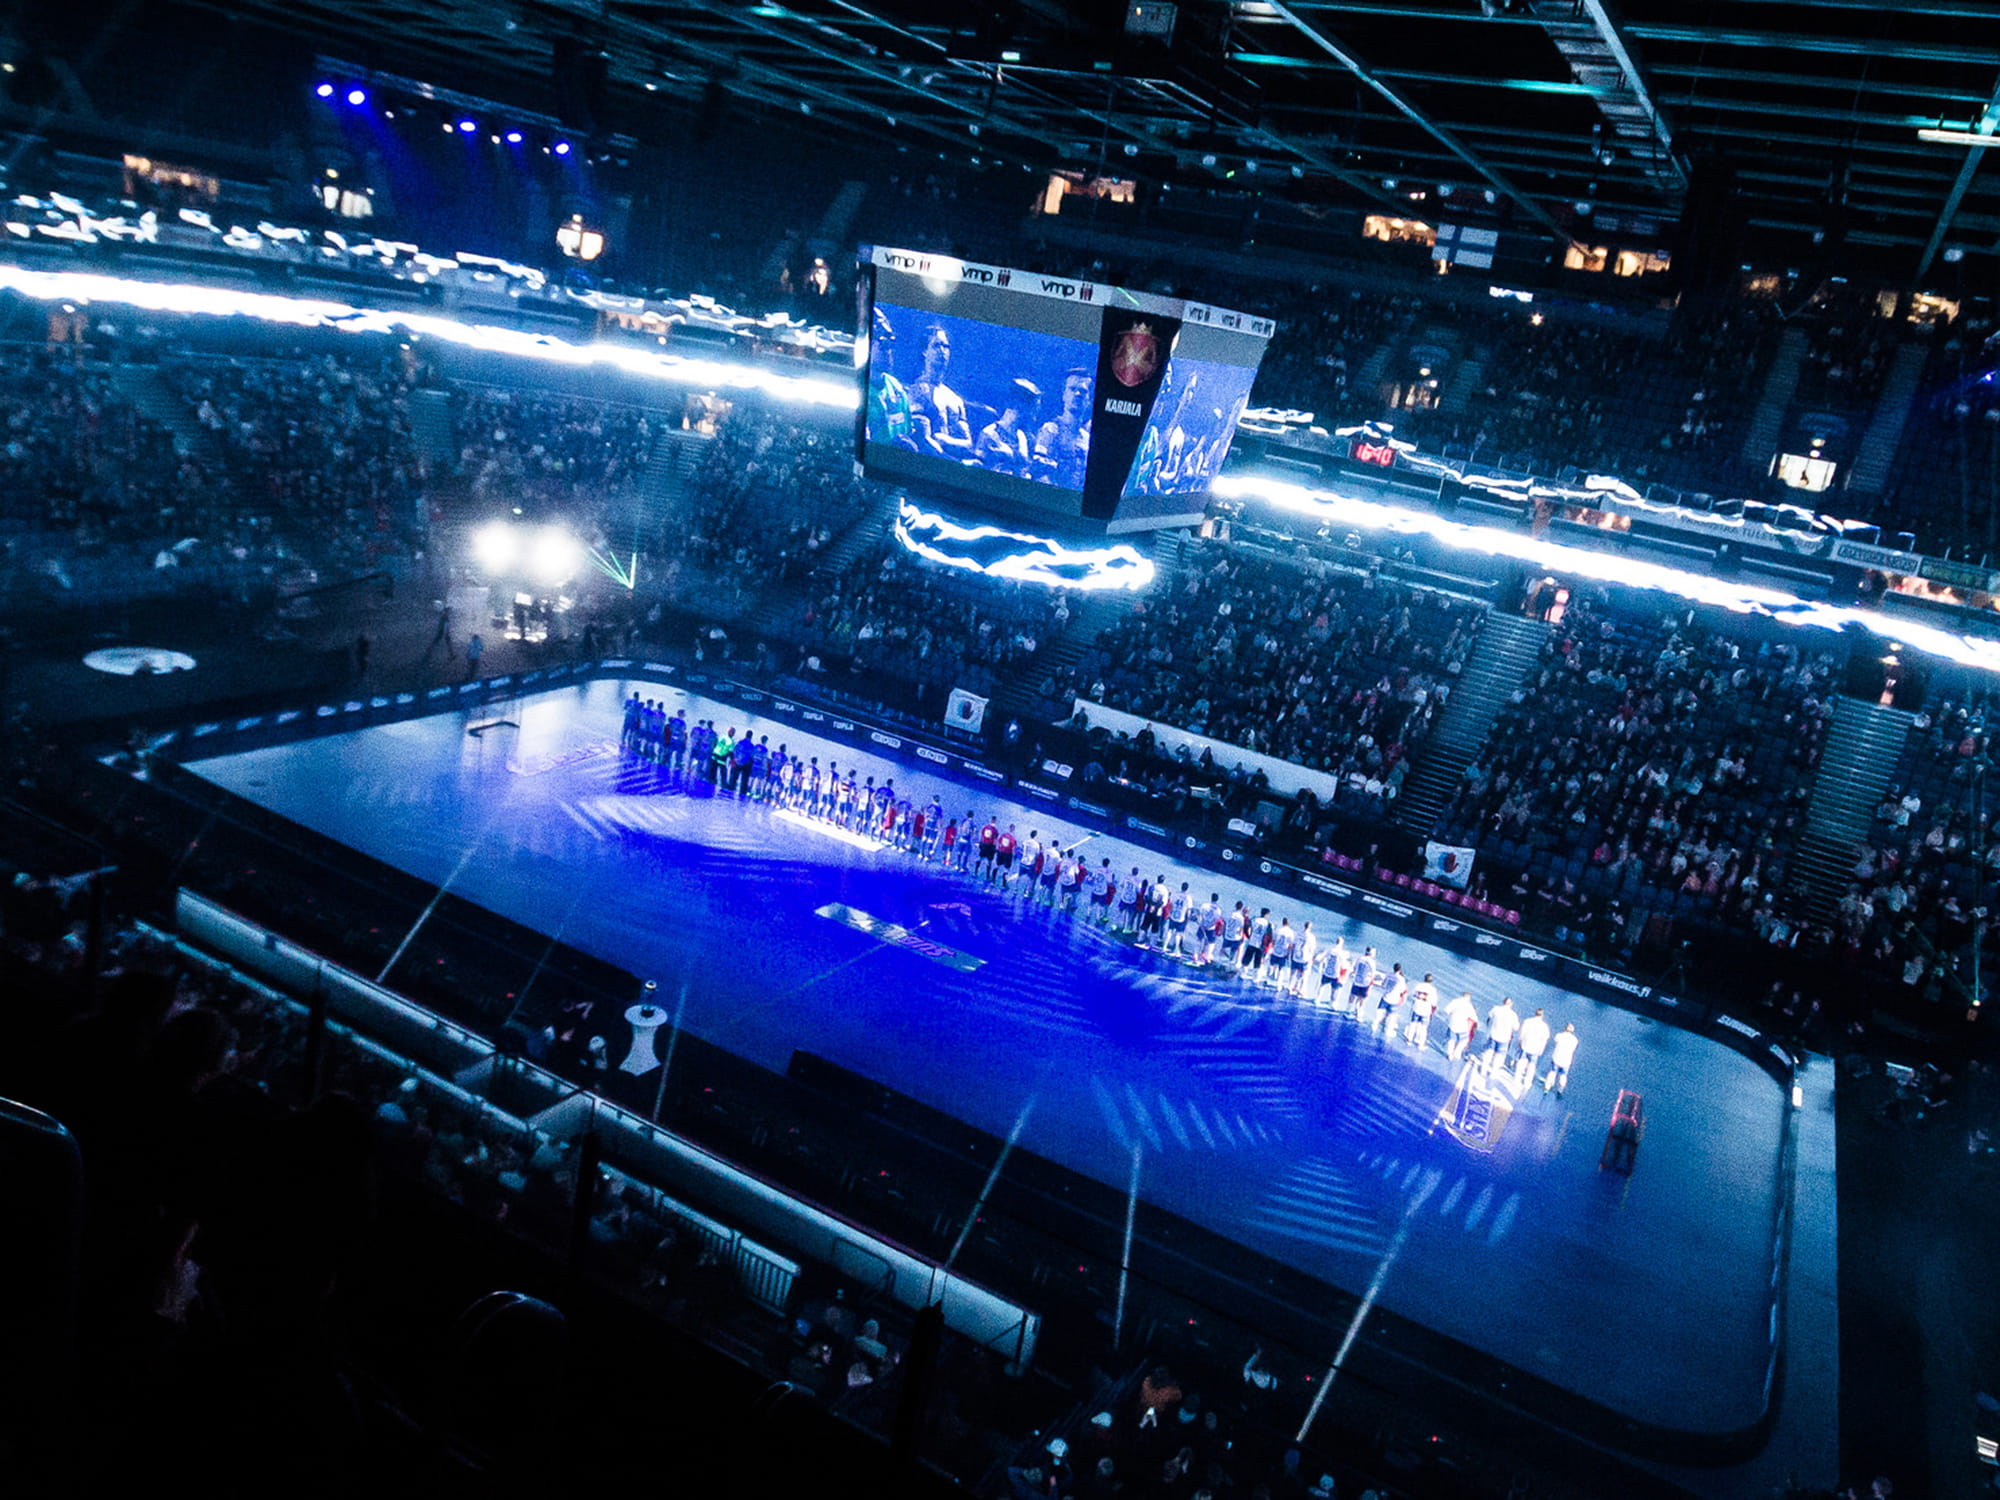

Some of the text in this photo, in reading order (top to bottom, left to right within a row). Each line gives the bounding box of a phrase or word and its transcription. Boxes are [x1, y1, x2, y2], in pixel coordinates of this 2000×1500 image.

[884, 252, 915, 268] vmp
[961, 266, 993, 285] vmp
[1041, 279, 1075, 298] vmp
[1104, 398, 1142, 417] KARJALA
